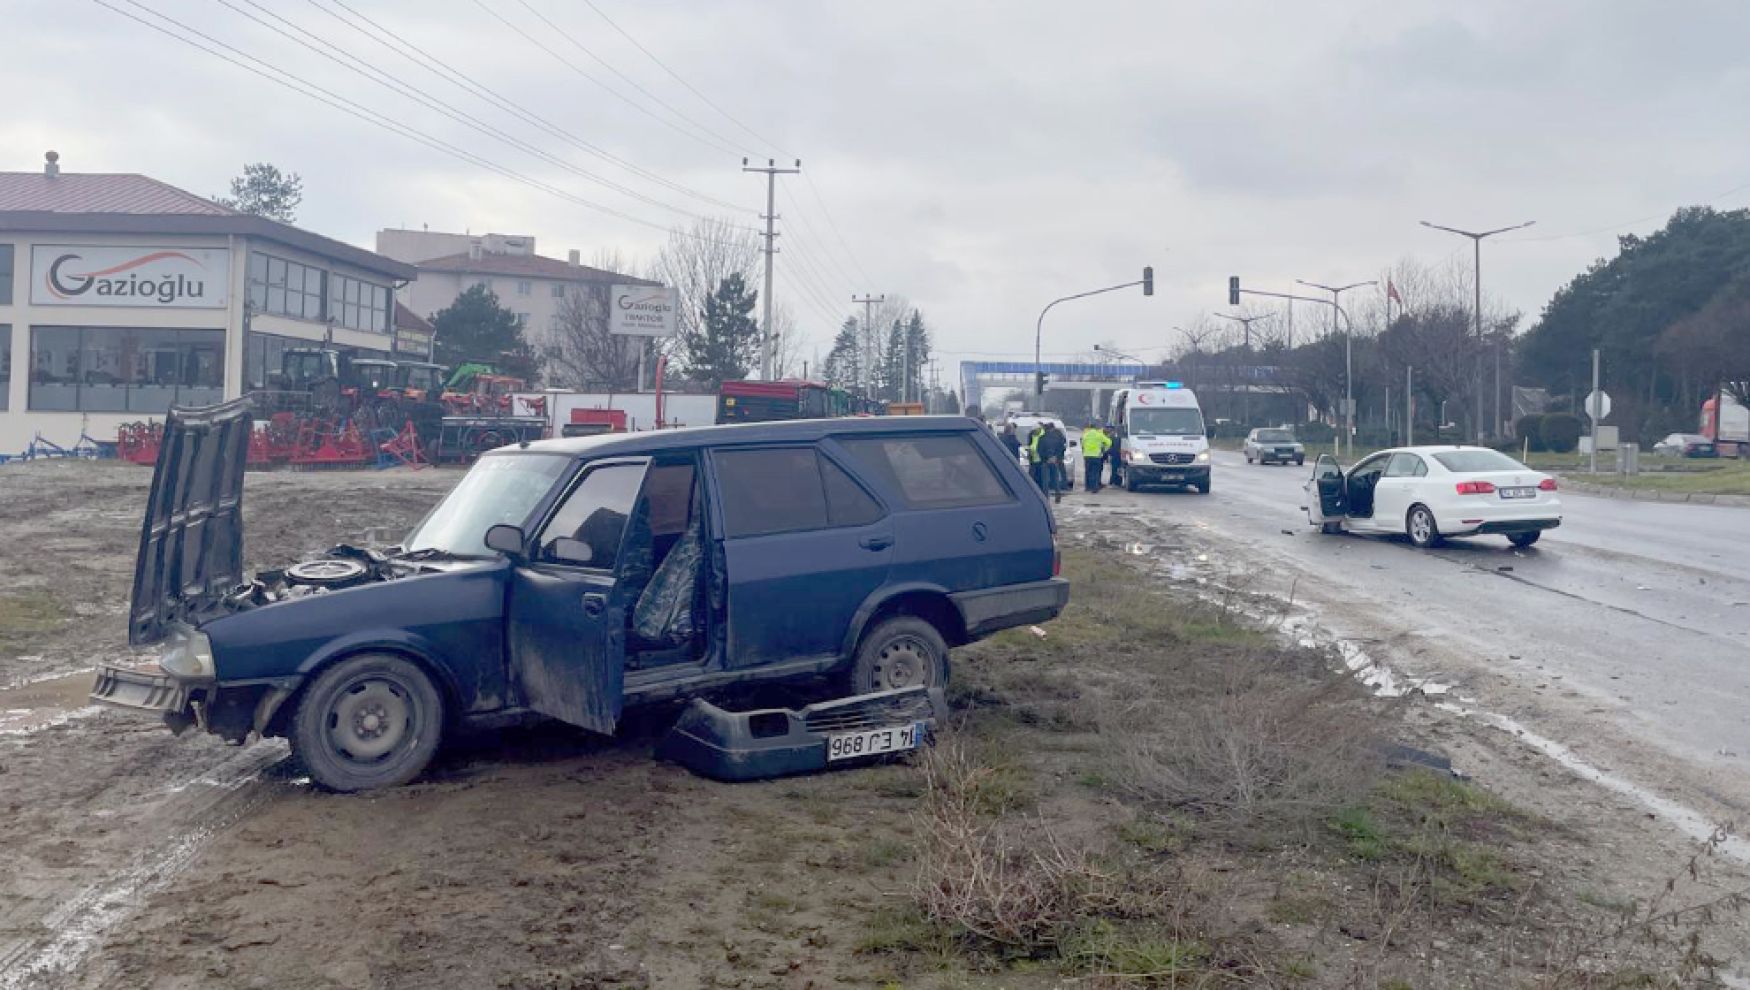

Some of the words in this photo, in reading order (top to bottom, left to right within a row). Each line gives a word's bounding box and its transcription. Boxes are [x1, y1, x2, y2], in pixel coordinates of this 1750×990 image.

[49, 253, 204, 303] Gazioğlu
[832, 734, 863, 756] 896
[867, 731, 892, 752] EJ
[900, 728, 913, 747] 14
